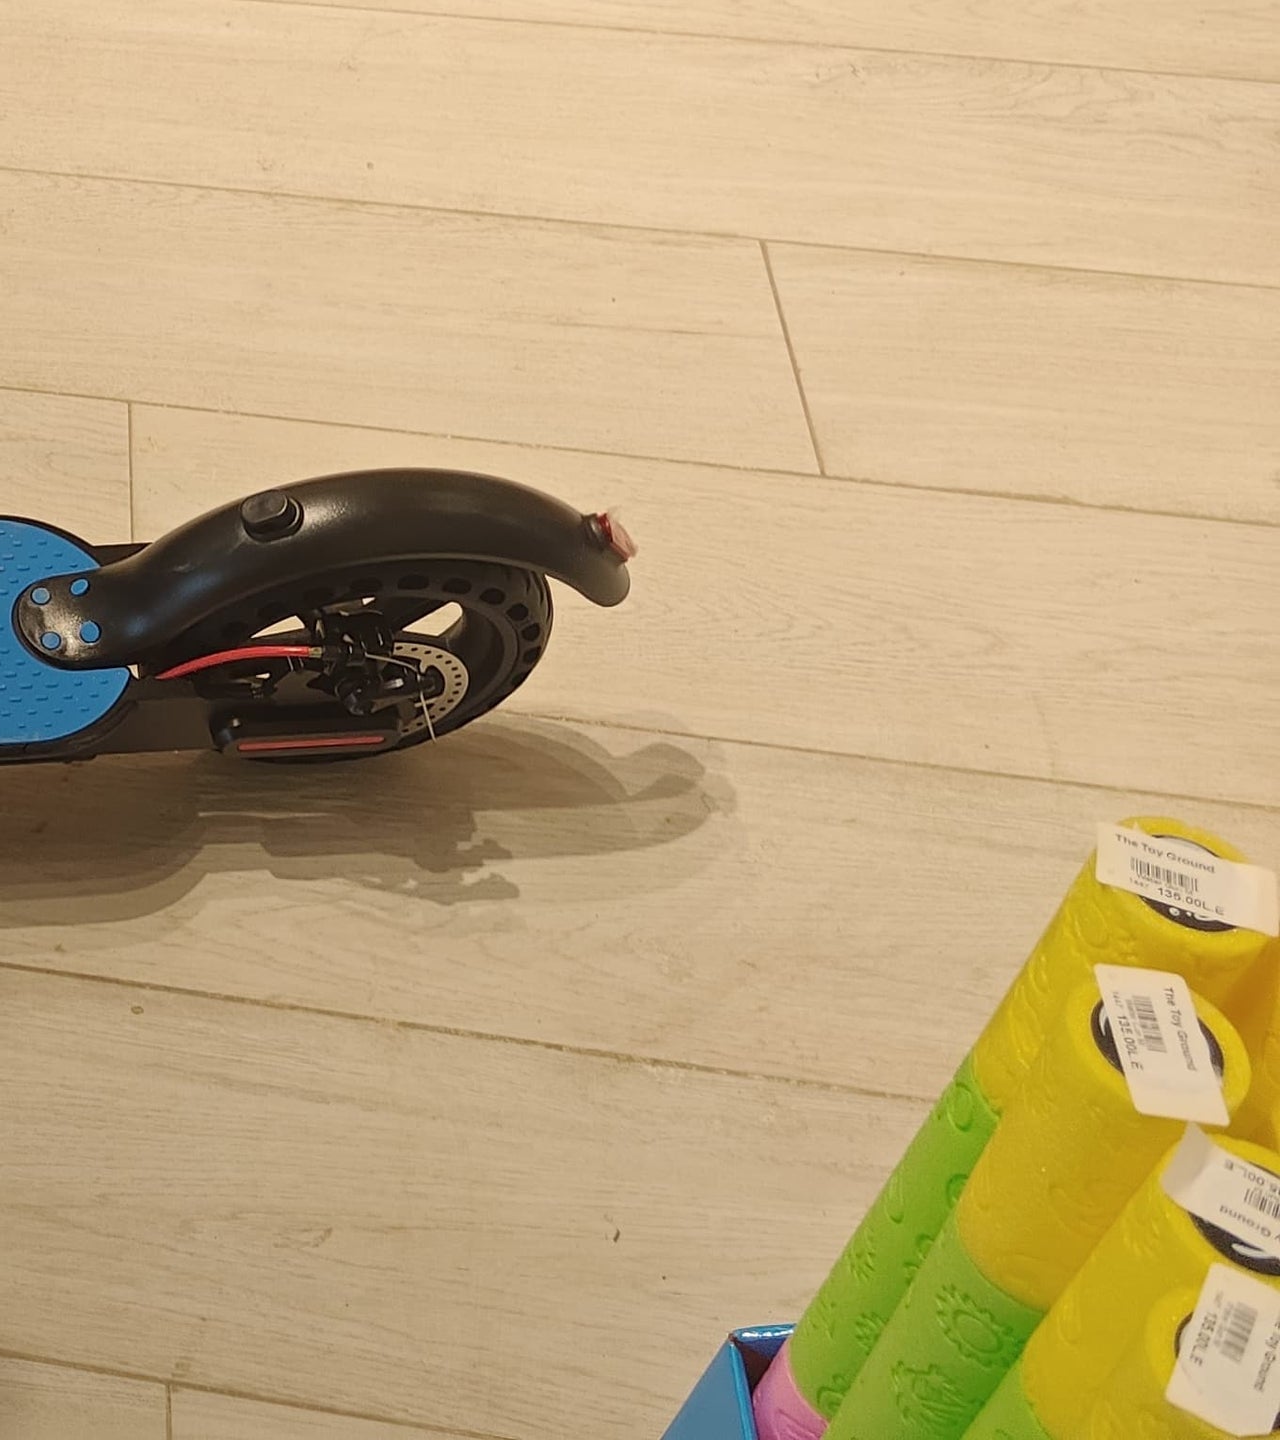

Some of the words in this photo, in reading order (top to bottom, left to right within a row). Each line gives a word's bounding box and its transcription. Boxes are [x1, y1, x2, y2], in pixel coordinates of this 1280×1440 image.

[1115, 833, 1138, 847] The
[1141, 841, 1163, 858] Toy
[1166, 851, 1216, 874] Ground
[1163, 986, 1176, 1006] The
[1170, 1009, 1182, 1027] Toy
[1177, 1030, 1199, 1072] Ground
[1219, 1204, 1271, 1239] Ground
